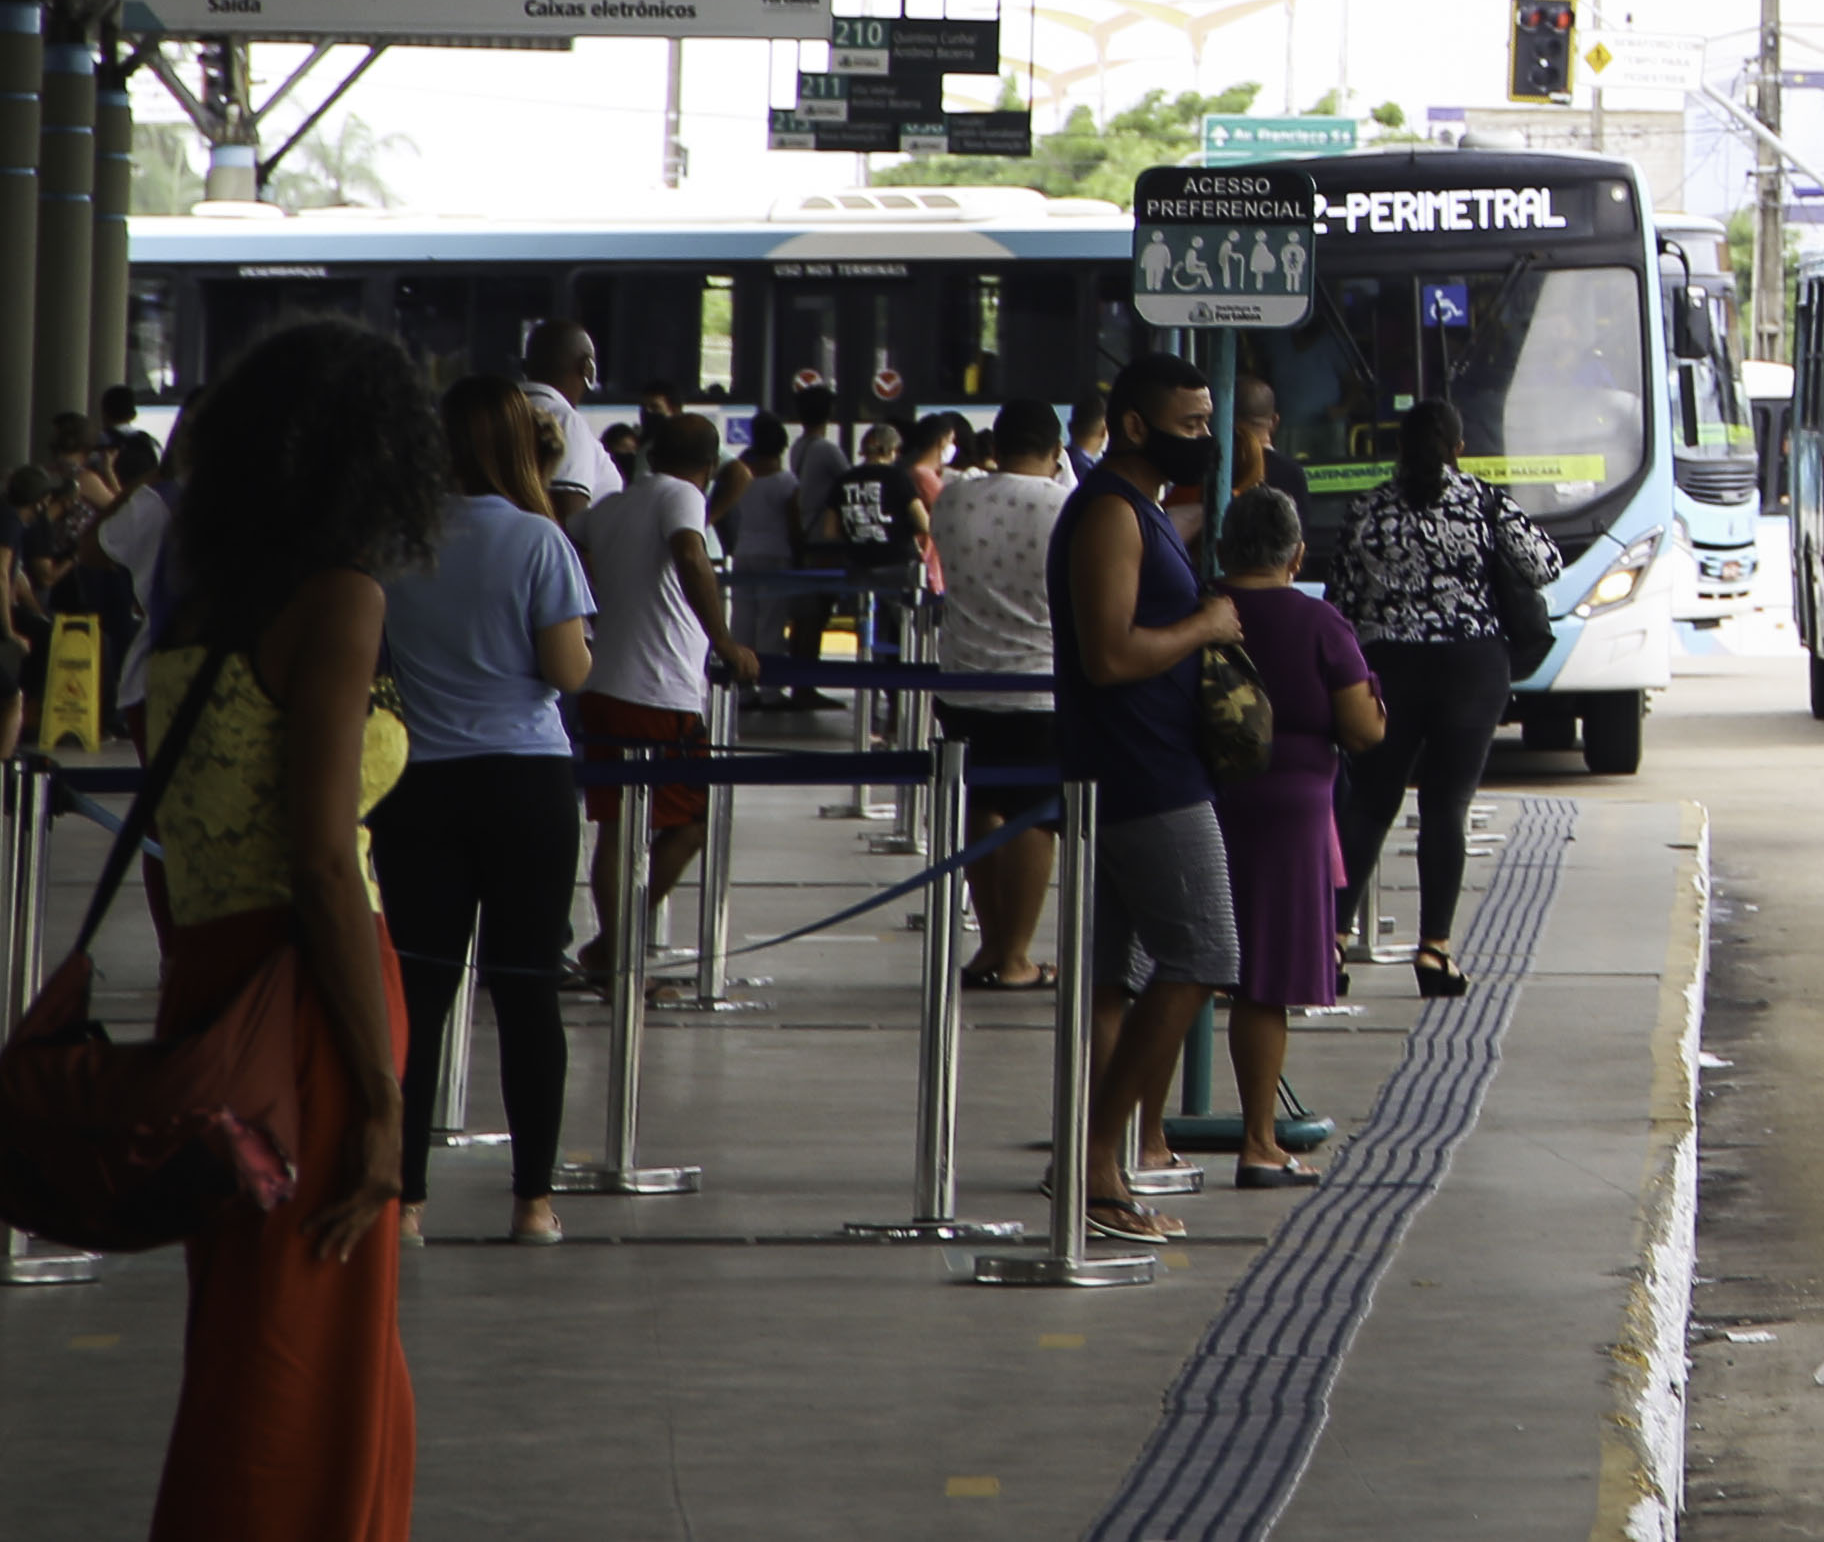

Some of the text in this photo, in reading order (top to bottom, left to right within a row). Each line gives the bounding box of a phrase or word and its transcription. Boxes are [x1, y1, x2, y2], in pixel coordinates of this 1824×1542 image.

[590, 0, 697, 20] eletrônicos
[835, 22, 882, 46] 210
[801, 75, 840, 97] 211
[1183, 177, 1271, 196] ACESSO
[1146, 199, 1307, 221] PREFERENCIAL
